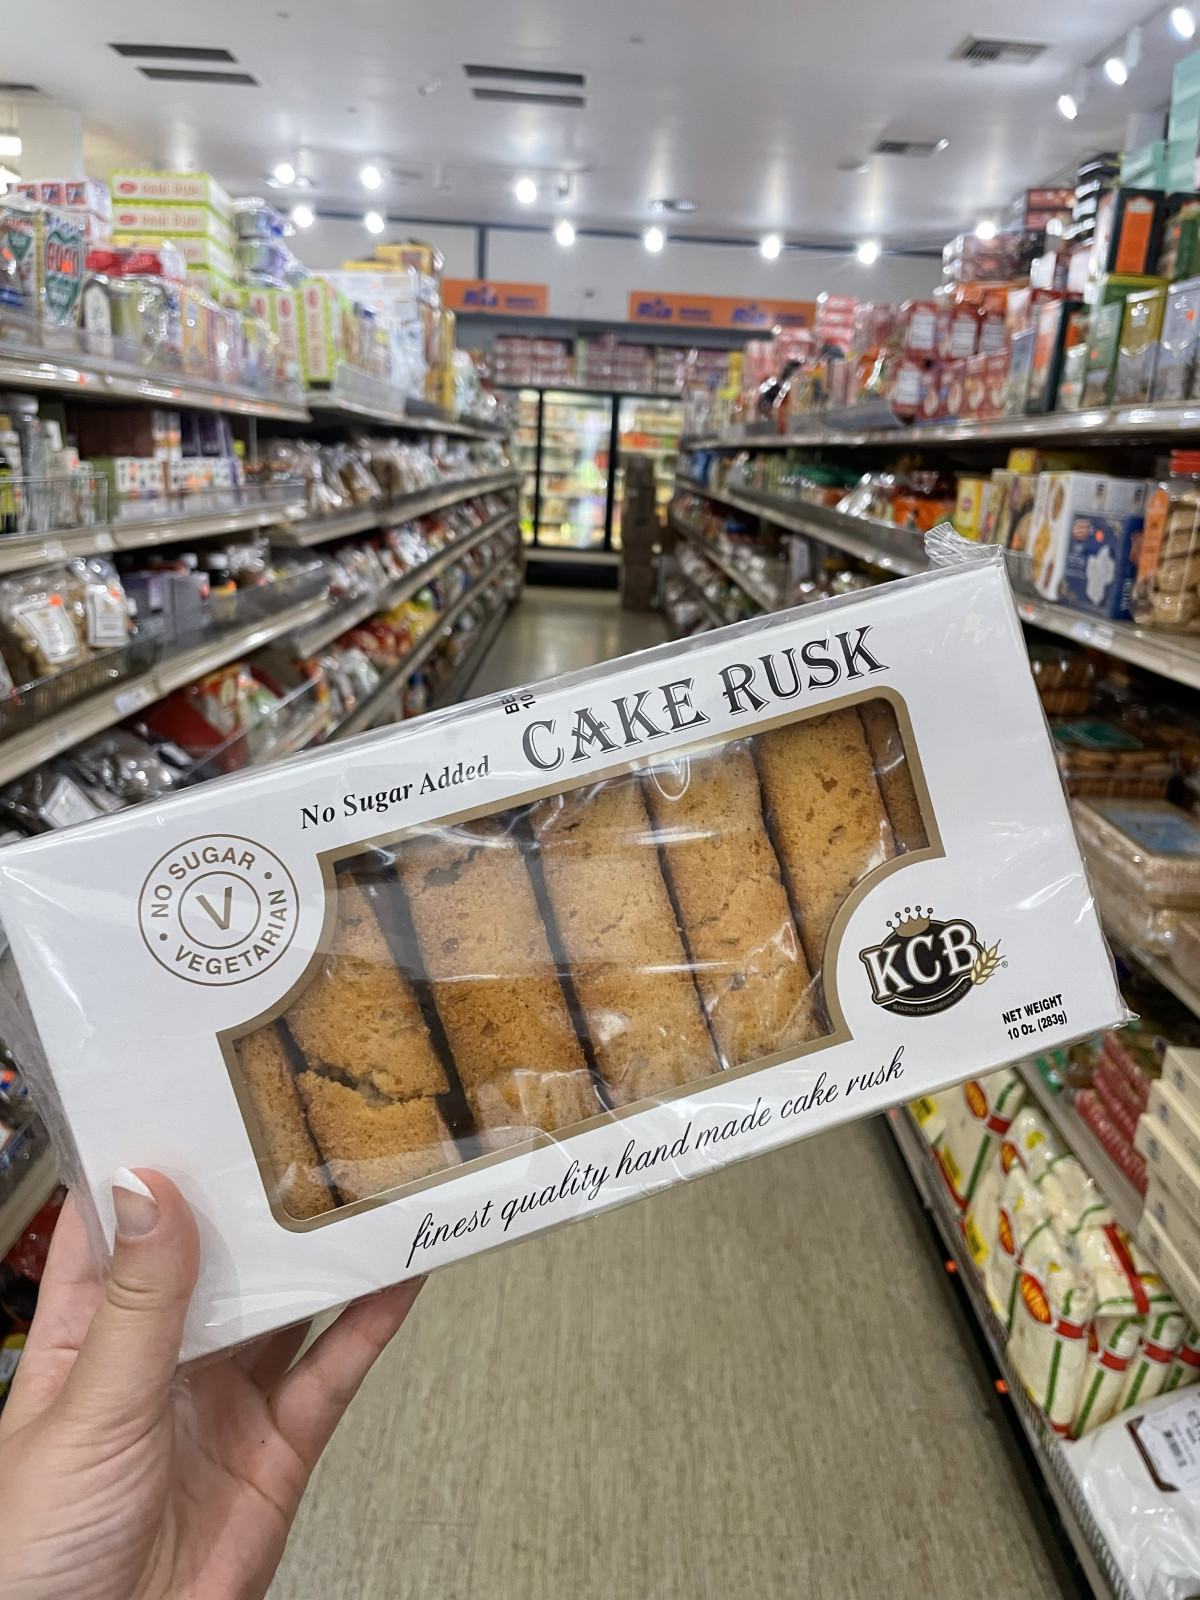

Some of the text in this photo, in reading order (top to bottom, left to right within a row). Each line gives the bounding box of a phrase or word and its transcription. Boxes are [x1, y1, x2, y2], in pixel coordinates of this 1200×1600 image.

[522, 625, 890, 772] CAKE RUSK
[300, 754, 492, 830] No Sugar Added
[151, 846, 256, 918] NO SUGAR
[195, 886, 233, 930] V
[175, 889, 288, 975] VEGETARIAN
[863, 923, 980, 998] KCB
[1002, 993, 1063, 1025] NET WEIGHT
[1007, 1010, 1068, 1040] 10 Oz. (283g)
[405, 1045, 906, 1269] finest quality hand made cake rusk
